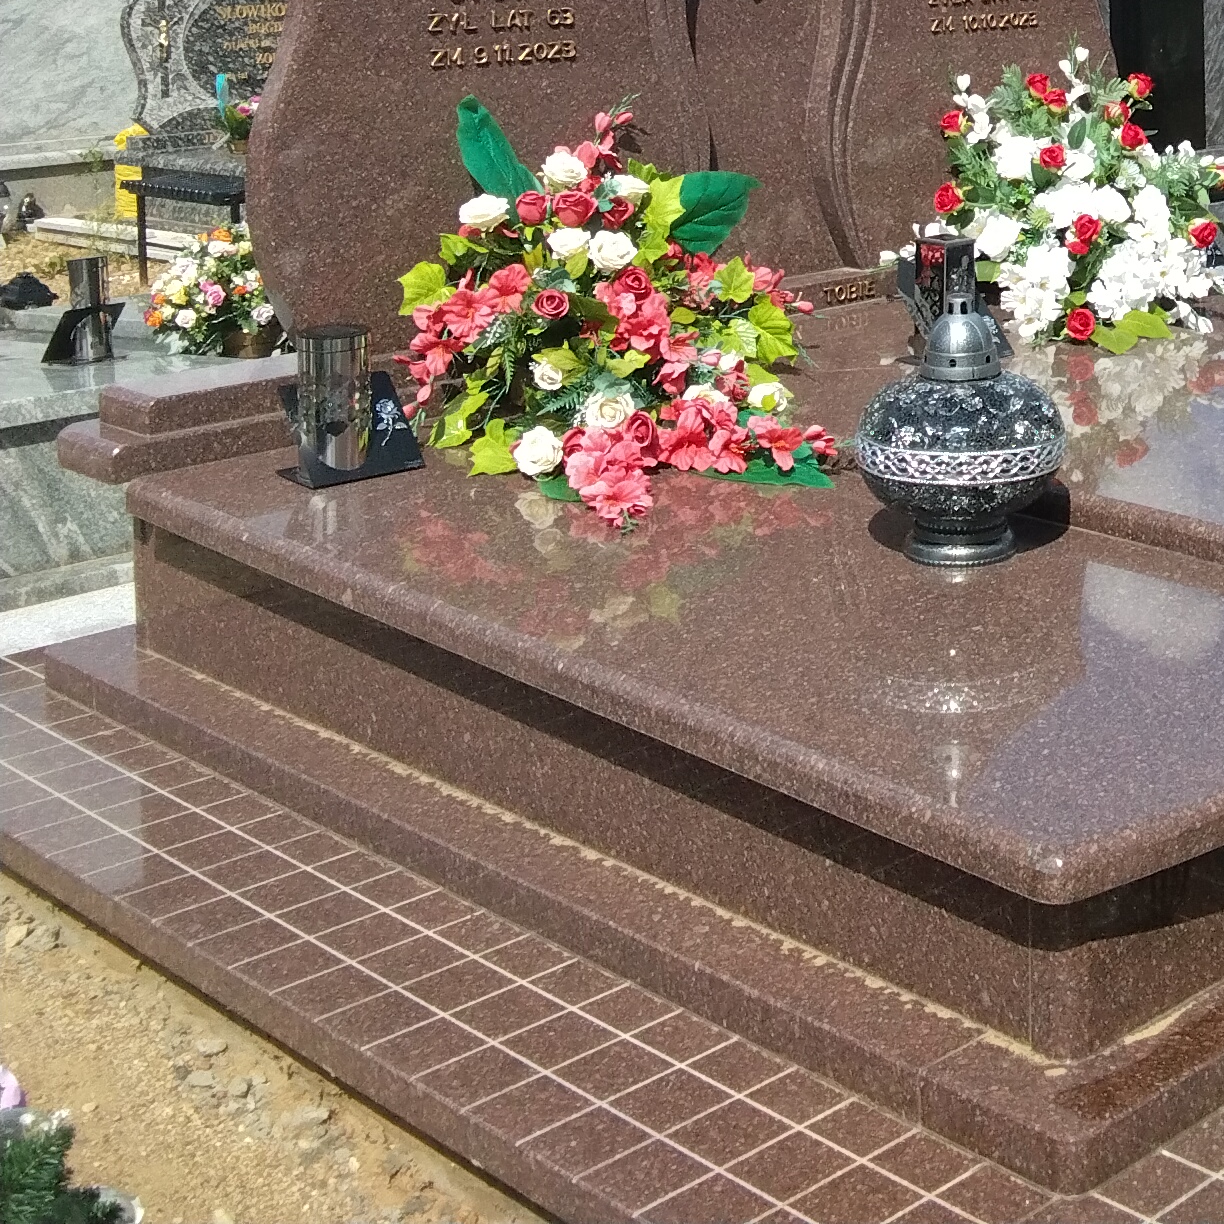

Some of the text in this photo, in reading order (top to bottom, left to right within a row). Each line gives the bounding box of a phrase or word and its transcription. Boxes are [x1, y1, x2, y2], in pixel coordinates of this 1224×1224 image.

[491, 9, 535, 29] LAT
[547, 6, 575, 26] 63
[822, 280, 876, 302] TOBIE
